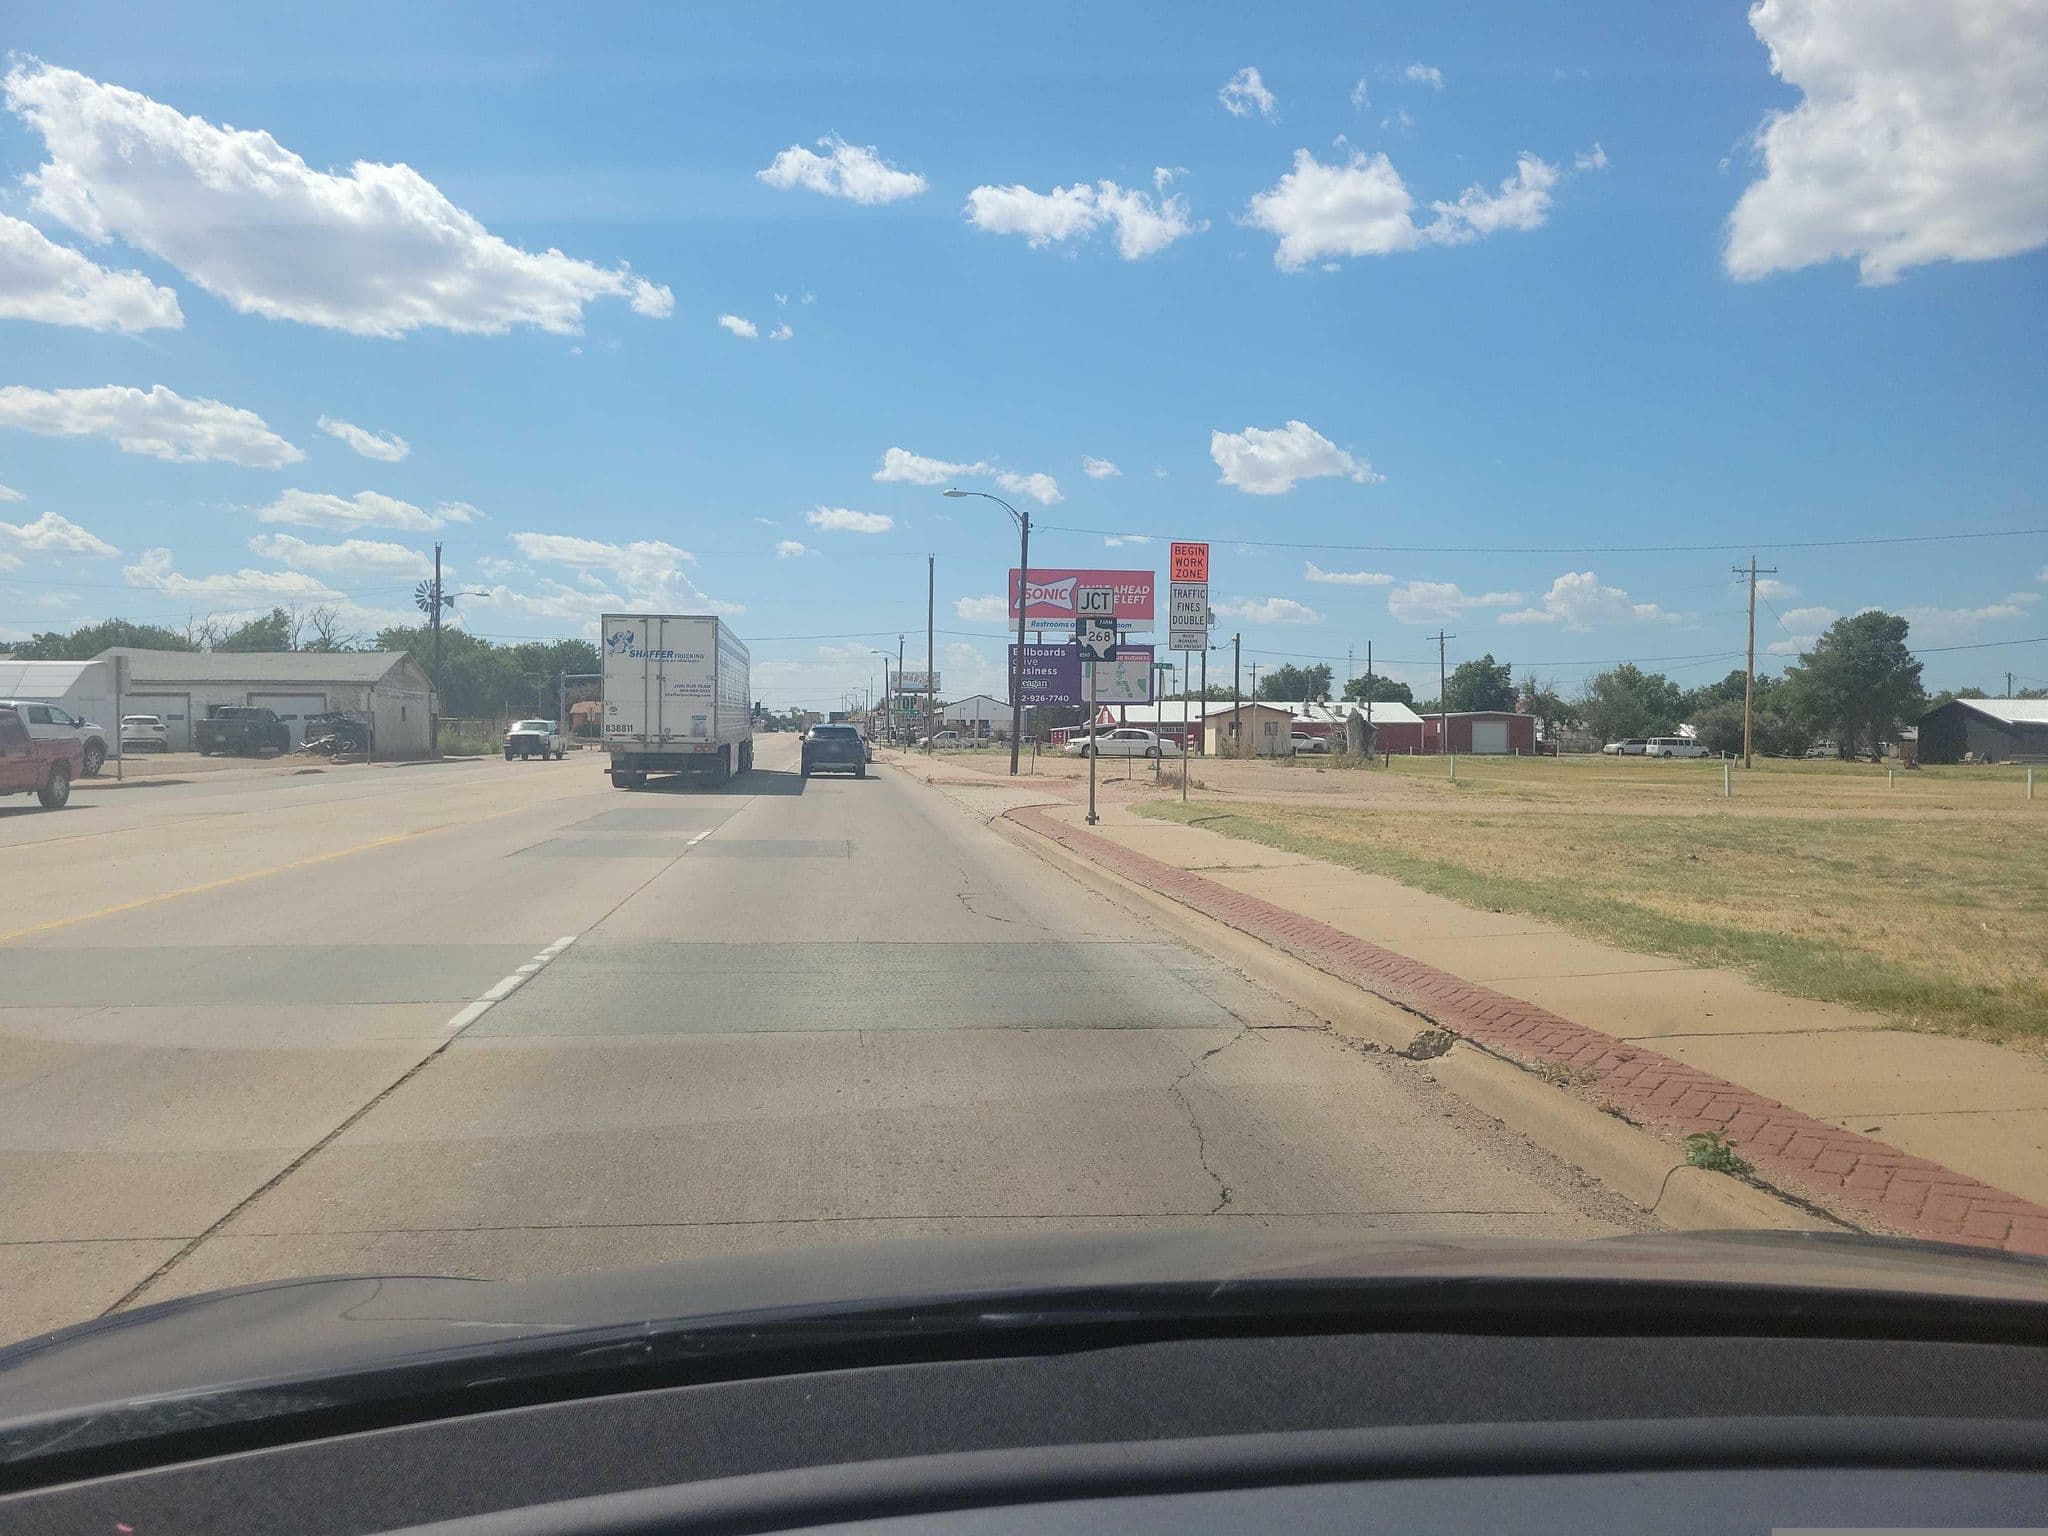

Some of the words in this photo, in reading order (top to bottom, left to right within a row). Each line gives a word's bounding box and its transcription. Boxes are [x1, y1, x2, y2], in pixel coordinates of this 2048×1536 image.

[1174, 546, 1205, 556] BEGIN
[1175, 558, 1204, 568] WORK
[1175, 569, 1203, 579] ZONE
[1024, 588, 1068, 601] SONIC
[1114, 585, 1150, 594] AHEAD
[1173, 588, 1206, 599] TRAFFIC
[1080, 592, 1110, 611] JCT
[1123, 596, 1147, 605] LEFT
[1177, 602, 1201, 612] FINES
[1030, 620, 1069, 628] Restrooms
[1172, 615, 1204, 625] DOUBLE
[1088, 631, 1111, 642] 268
[628, 649, 674, 658] SHAFFER
[1012, 647, 1066, 657] Bllboards
[1012, 666, 1058, 675] Bsiness
[1021, 680, 1047, 689] eagan
[605, 724, 634, 733] 838811
